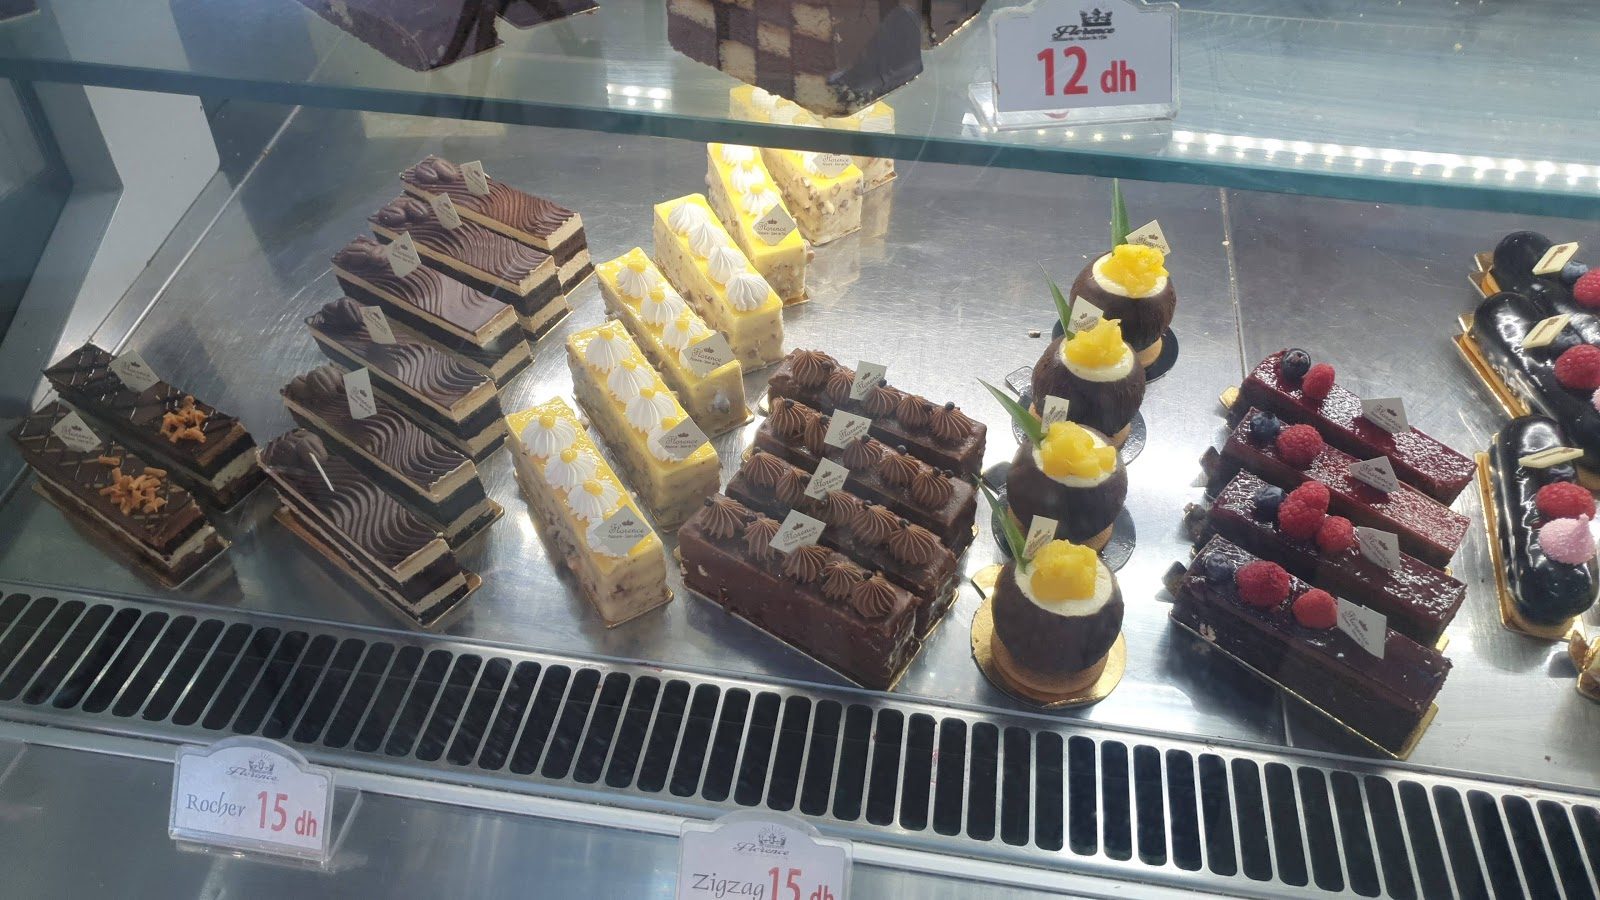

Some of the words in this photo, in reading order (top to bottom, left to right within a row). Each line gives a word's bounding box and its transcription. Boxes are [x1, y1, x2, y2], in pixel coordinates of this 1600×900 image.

[1052, 25, 1115, 39] Florence
[1037, 46, 1088, 96] 12
[1100, 60, 1137, 93] dh
[225, 766, 280, 782] Florence
[185, 791, 246, 818] Rocher
[257, 791, 289, 832] 15
[294, 810, 318, 838] dh
[733, 841, 790, 857] Florence
[692, 872, 765, 900] Zigzag
[768, 866, 803, 900] 15
[809, 884, 835, 900] dh
